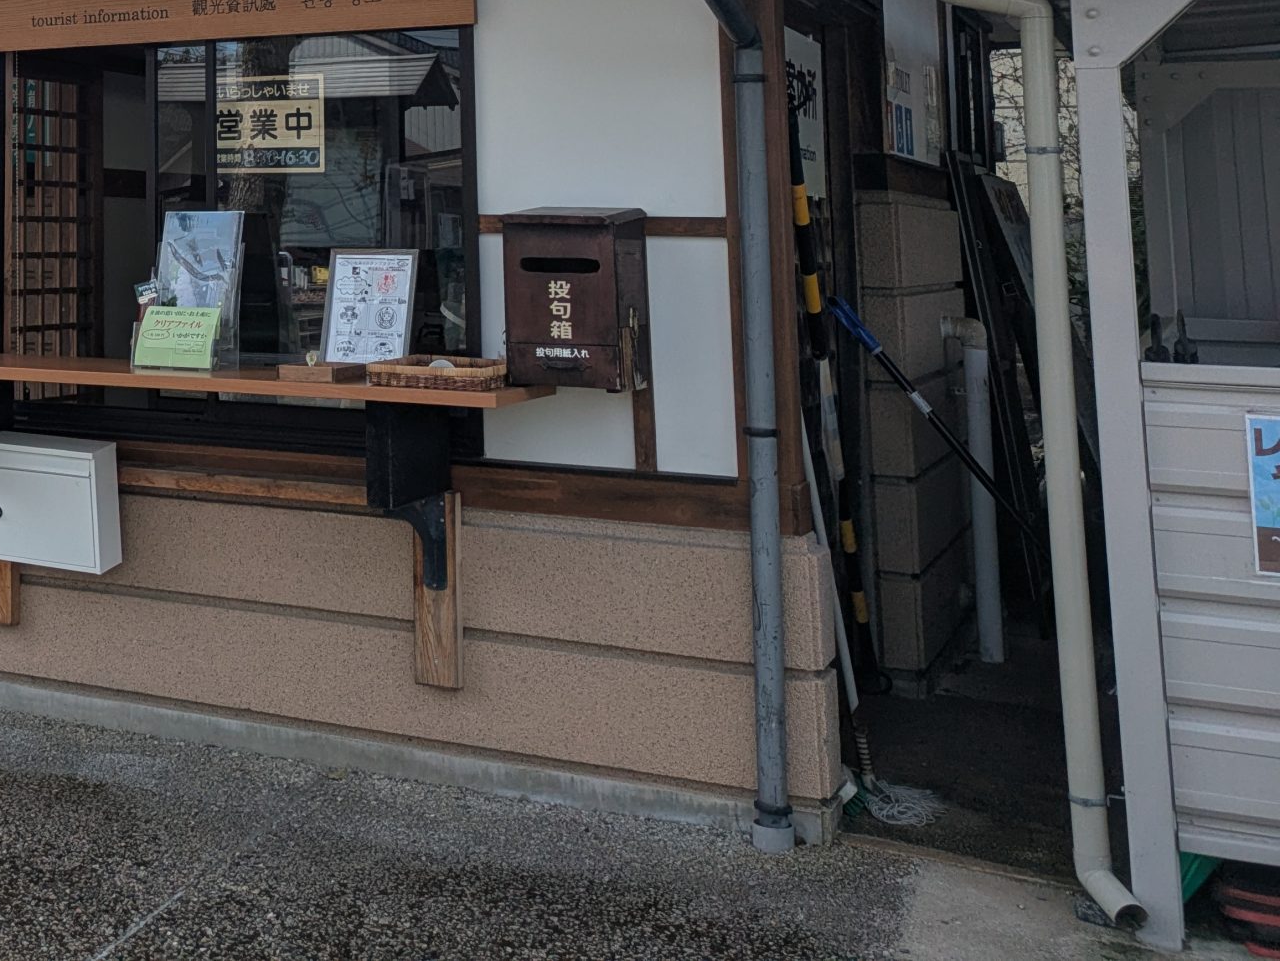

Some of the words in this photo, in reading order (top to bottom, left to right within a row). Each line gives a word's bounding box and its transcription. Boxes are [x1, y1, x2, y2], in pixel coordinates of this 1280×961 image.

[31, 11, 79, 28] tourist
[83, 4, 170, 25] information
[218, 82, 310, 99] いらっしゃいませ
[217, 107, 313, 140] 営業中
[548, 279, 573, 340] 投句箱
[153, 319, 204, 329] クリアファイル
[172, 331, 208, 339] いかがですか
[535, 347, 590, 359] 投句用紙入れ
